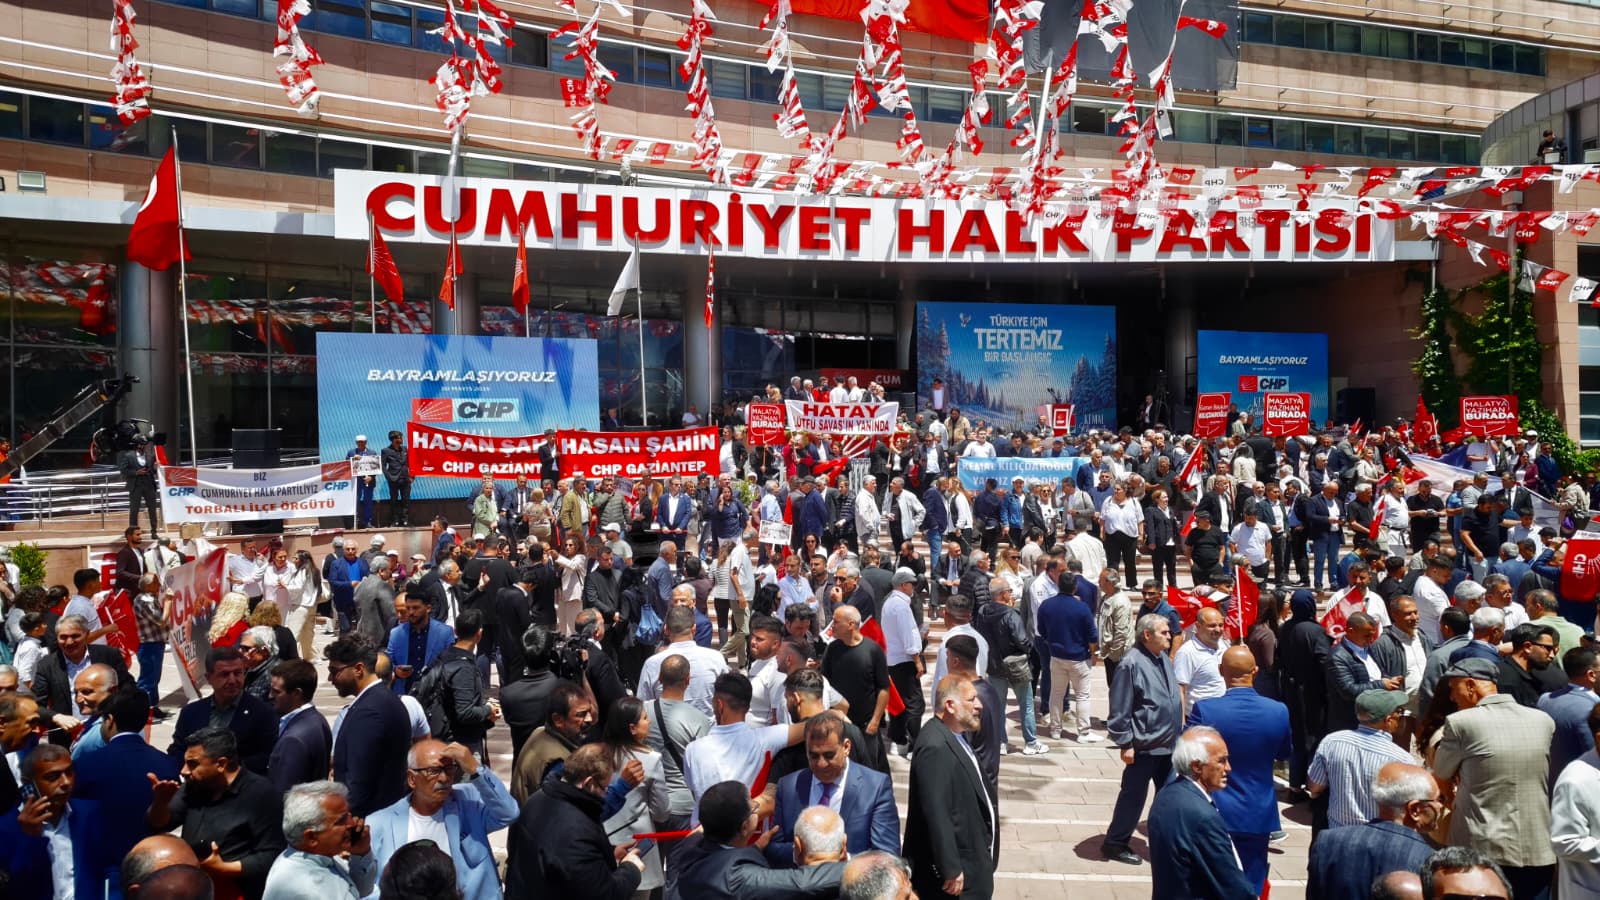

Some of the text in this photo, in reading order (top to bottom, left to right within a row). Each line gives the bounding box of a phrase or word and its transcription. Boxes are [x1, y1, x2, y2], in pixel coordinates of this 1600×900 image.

[366, 182, 1372, 254] CUMHURİYET HALK PARTİSİ
[1515, 230, 1535, 238] CHP
[990, 314, 1028, 327] TÜRKİYE
[973, 328, 1064, 350] TERTEMİZ
[1219, 355, 1308, 366] BAYRAMLAŞIYORUZ
[367, 369, 557, 384] BAYRAMLAŞIYORUZ
[875, 375, 902, 385] CUM
[1259, 378, 1287, 390] CHP
[457, 401, 515, 419] CHP
[803, 403, 880, 418] HATAY
[1465, 412, 1515, 420] BURADA
[855, 419, 890, 432] YANINDA
[412, 431, 548, 458] HASAN ŞAH
[560, 431, 716, 458] HASAN ŞAHİN
[442, 460, 542, 474] CHP GAZİANT
[591, 464, 622, 475] CHP
[625, 460, 707, 475] GAZİANTEP
[168, 487, 196, 497] CHP
[254, 487, 276, 498] HALK
[324, 481, 349, 491] CHP
[185, 499, 336, 515] TORBALI İLÇE ÖRGÜTÜ
